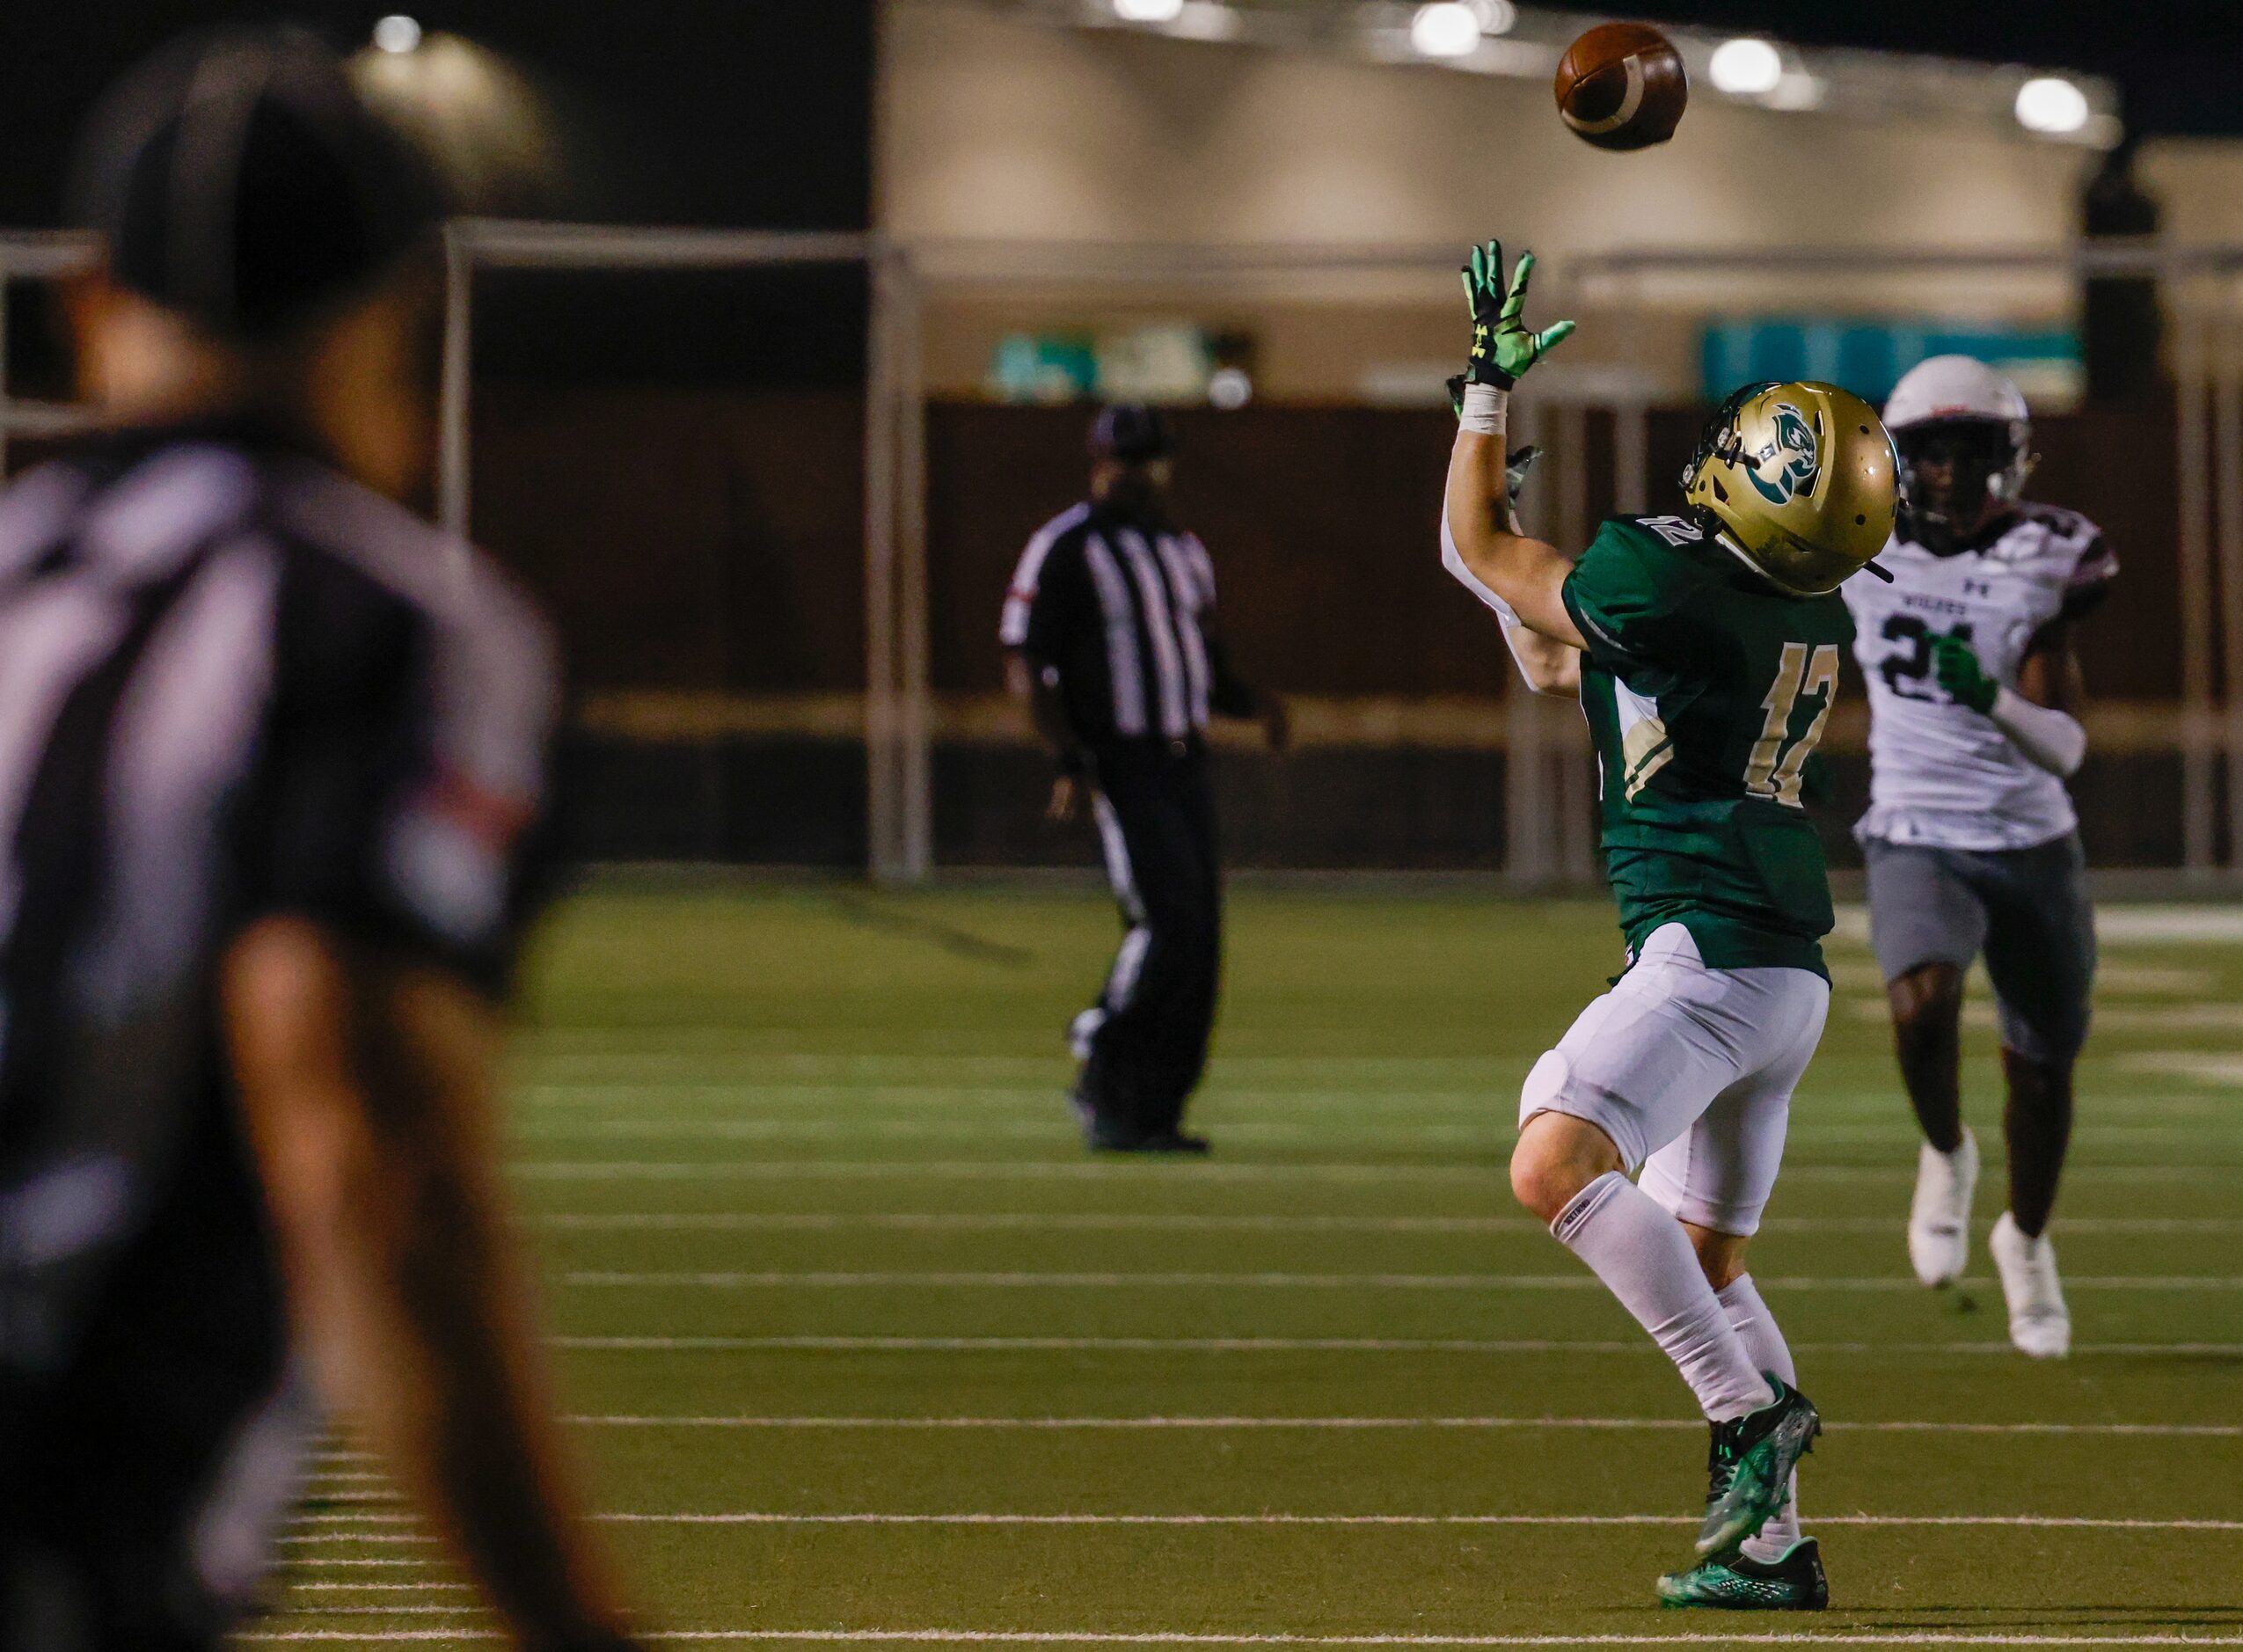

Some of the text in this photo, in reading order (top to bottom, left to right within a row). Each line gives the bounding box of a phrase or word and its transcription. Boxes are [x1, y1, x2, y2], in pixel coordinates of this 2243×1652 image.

[1635, 515, 1704, 546] 12
[1881, 613, 1972, 704] 2
[1742, 642, 1839, 808] 12
